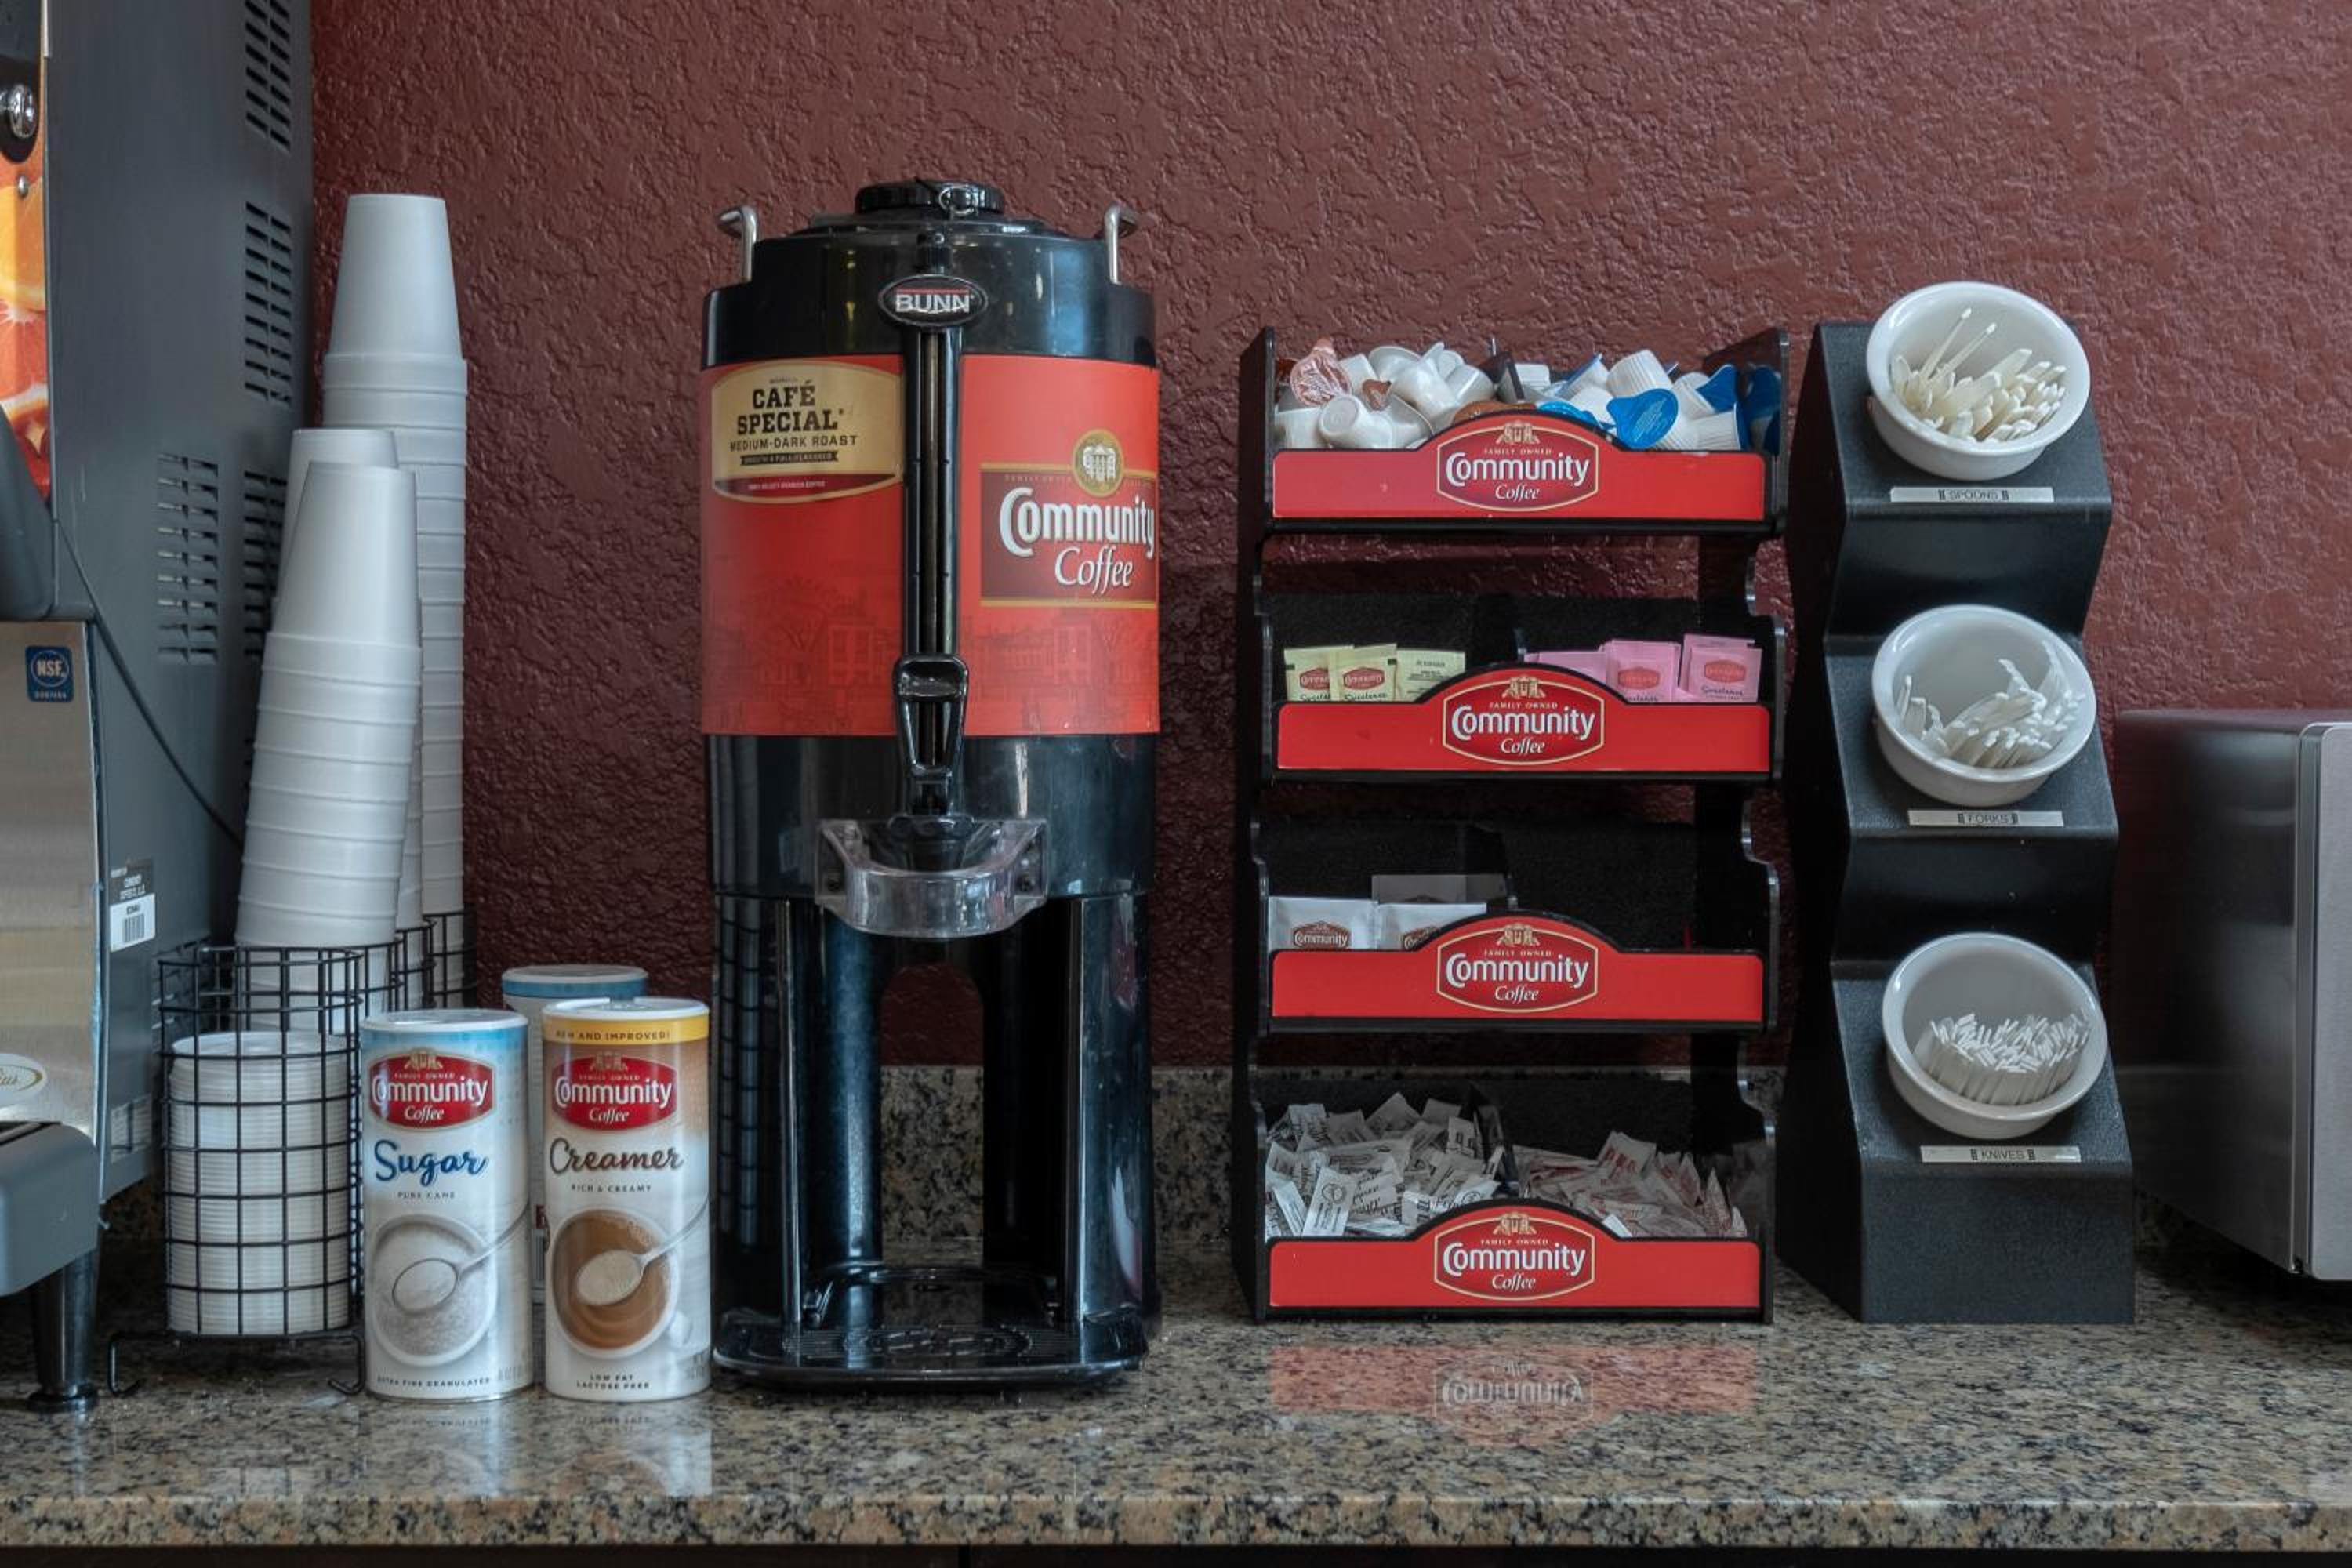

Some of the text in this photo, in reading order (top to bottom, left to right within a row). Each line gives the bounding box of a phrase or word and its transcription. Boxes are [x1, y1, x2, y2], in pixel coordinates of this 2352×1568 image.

[895, 293, 970, 313] BUNN
[752, 379, 816, 409] CAFÉ
[737, 408, 839, 435] SPECIAL
[729, 434, 859, 452] MEDIUM-DARK ROAST
[1446, 452, 1589, 487] Community
[1495, 483, 1541, 502] Coffee
[1000, 486, 1155, 559] Community
[1054, 545, 1134, 594] Coffee
[37, 659, 62, 677] NSF
[1452, 705, 1595, 741] Community
[1500, 737, 1545, 756] Coffee
[1294, 931, 1348, 947] Community
[1446, 953, 1589, 989] Community
[1494, 985, 1539, 1004] Coffee
[579, 1031, 601, 1040] AND
[372, 1074, 488, 1106] Community
[555, 1076, 672, 1109] Community
[405, 1105, 445, 1123] Coffee
[589, 1107, 630, 1124] Coffee
[374, 1139, 490, 1186] Sugar
[550, 1137, 684, 1174] Creamer
[1982, 1149, 2025, 1160] KNIVES
[571, 1184, 593, 1192] RICH
[1443, 1242, 1586, 1277] Community
[1492, 1272, 1536, 1292] Coffee
